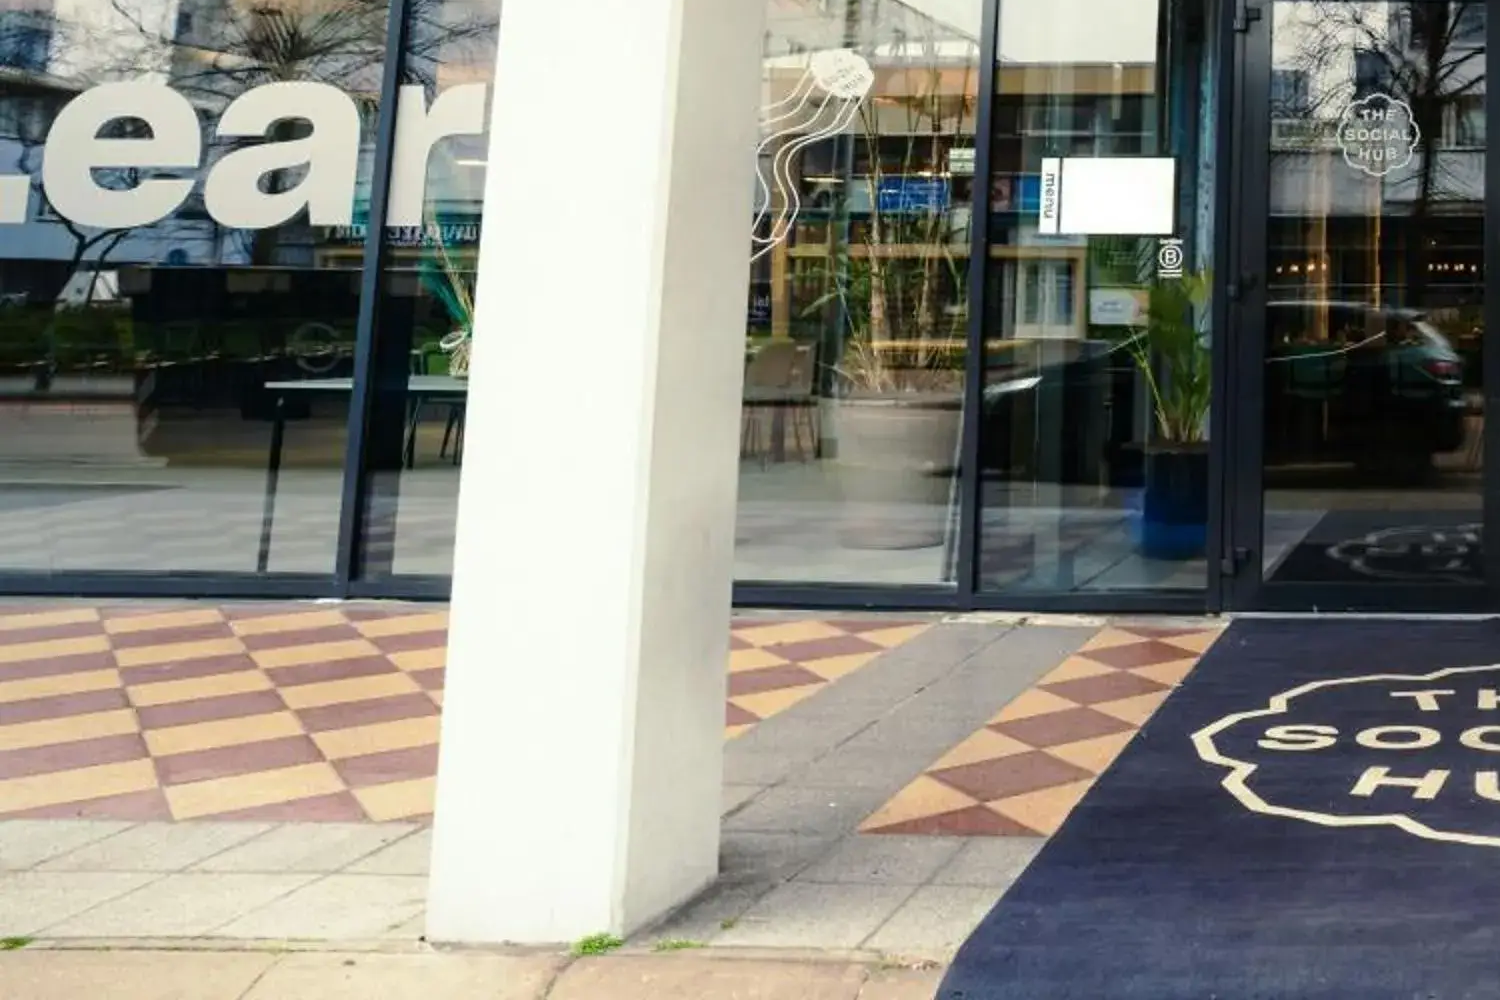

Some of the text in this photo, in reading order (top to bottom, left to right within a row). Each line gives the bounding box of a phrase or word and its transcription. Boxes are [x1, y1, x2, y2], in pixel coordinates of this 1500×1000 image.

[1360, 109, 1397, 121] THE
[1344, 128, 1412, 141] SOCIAL
[0, 80, 489, 228] ear
[1359, 147, 1398, 161] HUB
